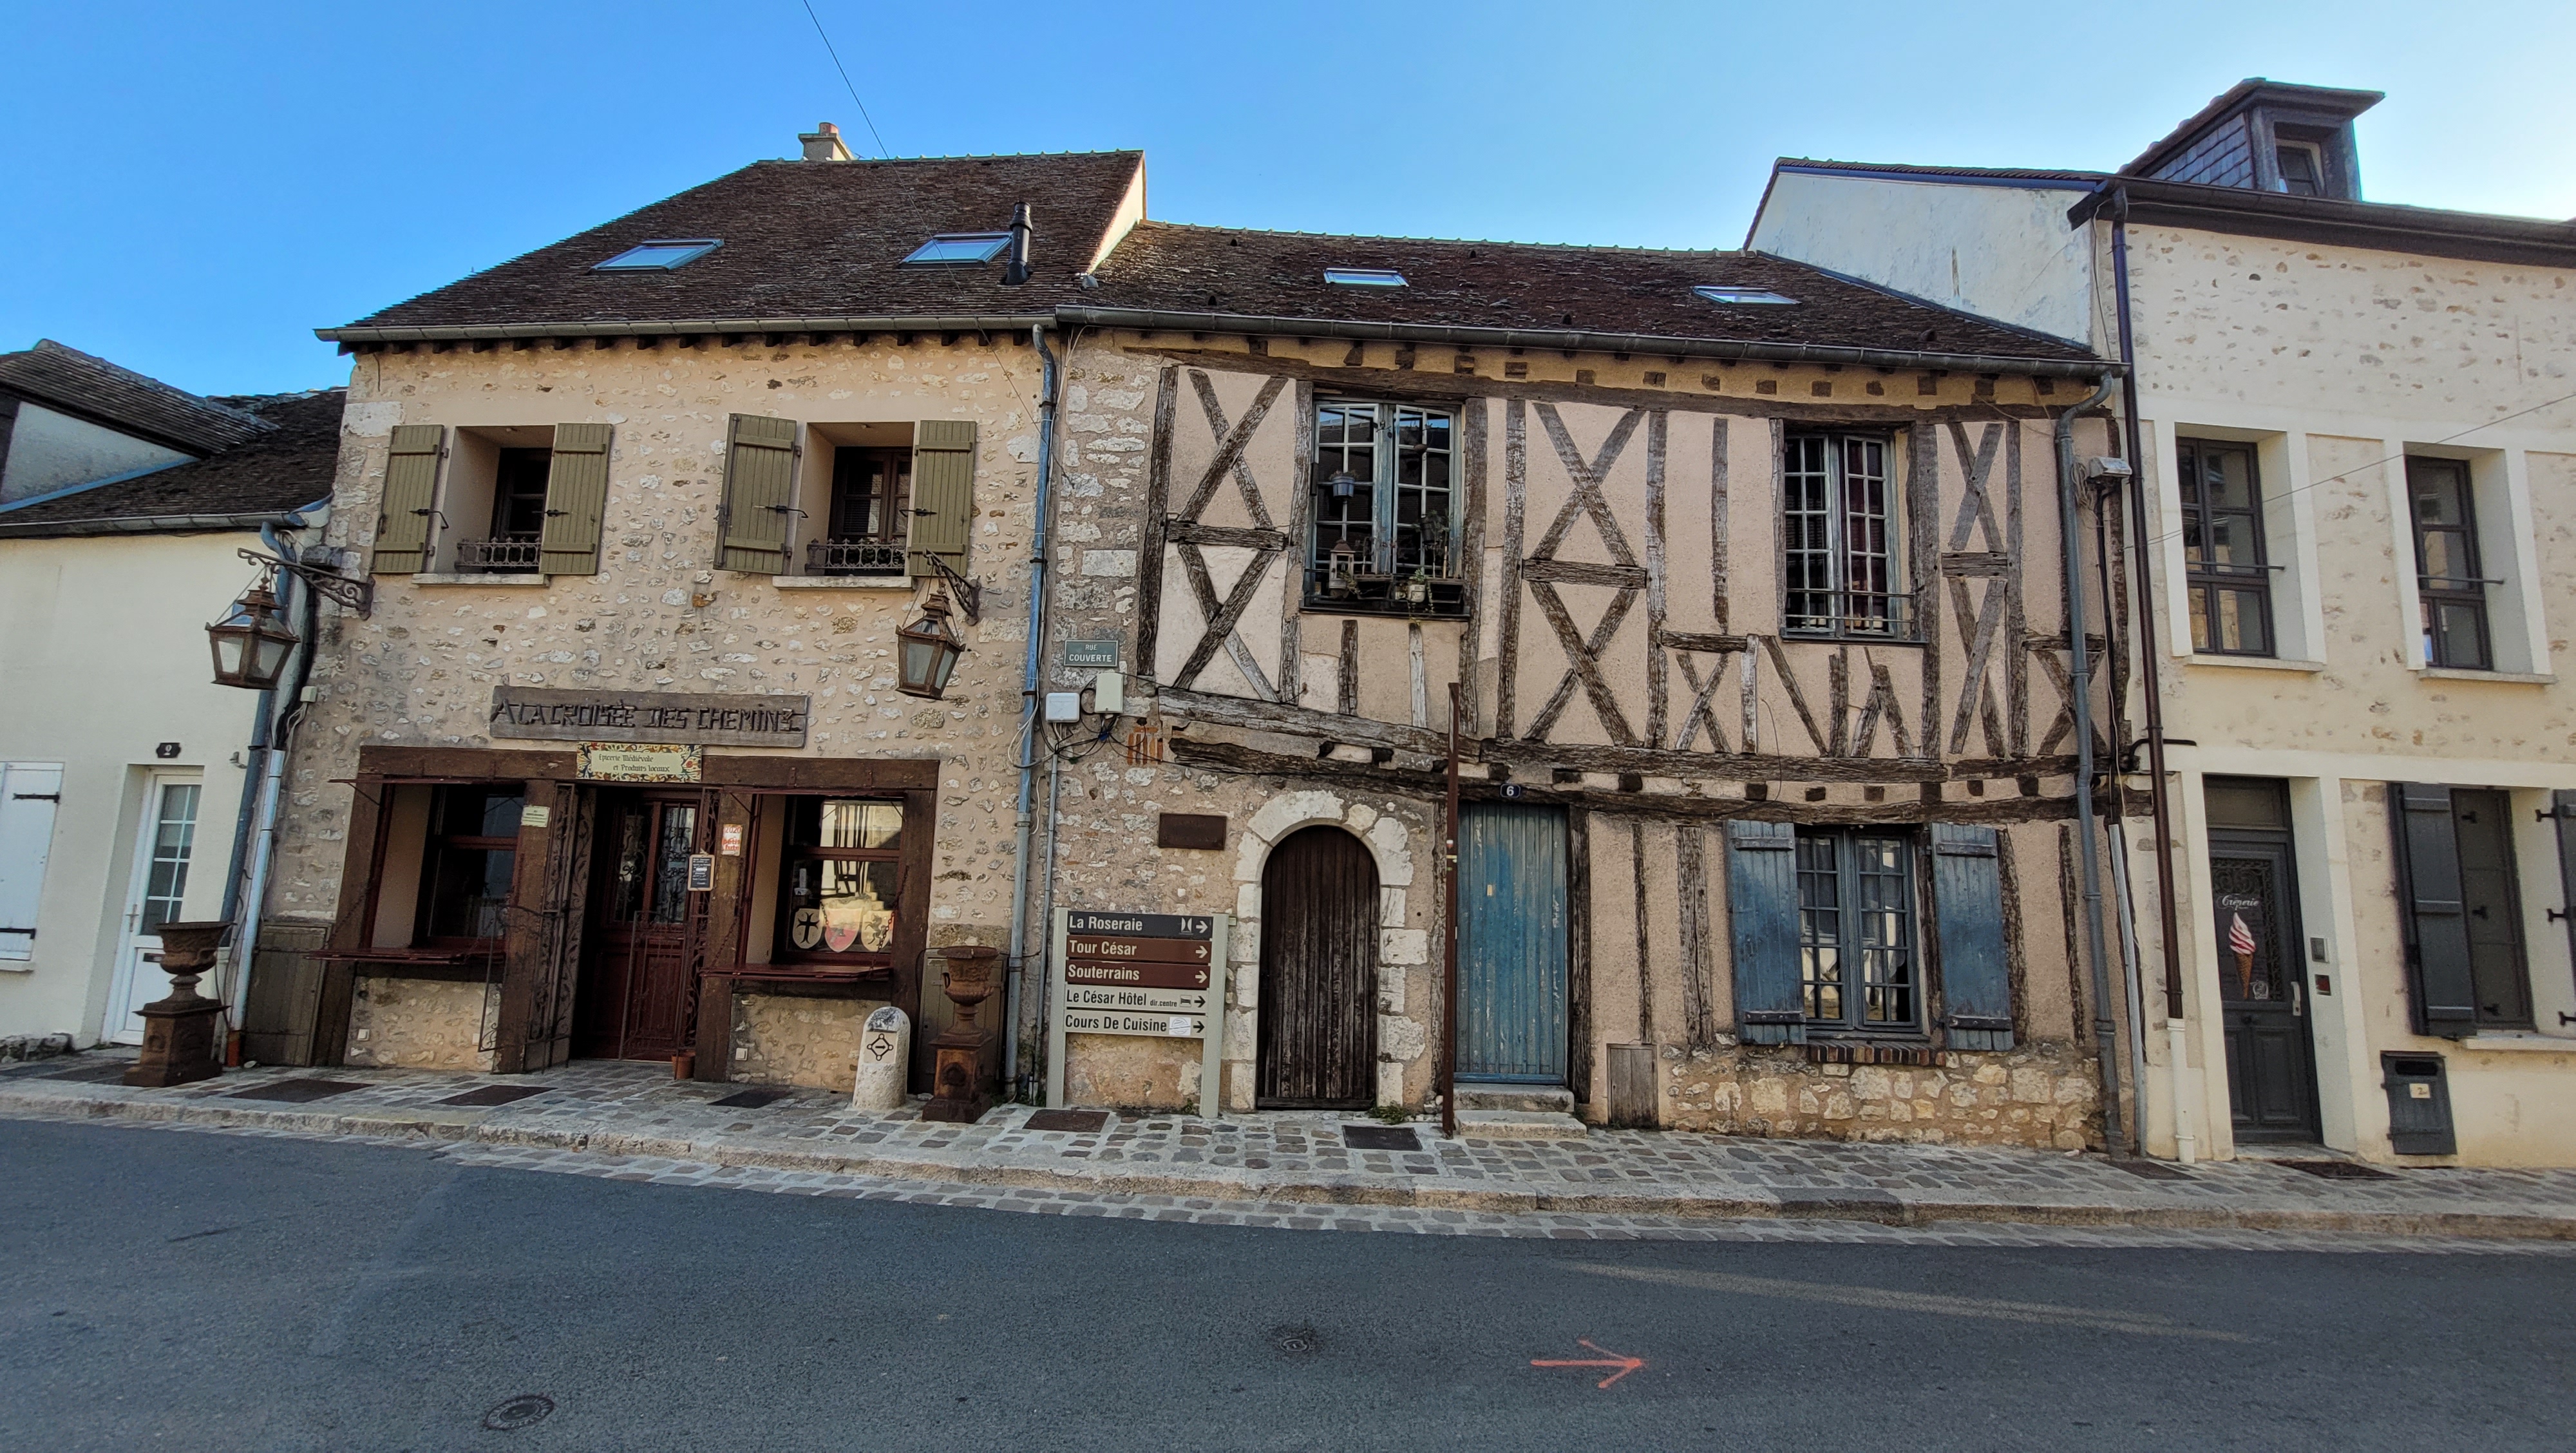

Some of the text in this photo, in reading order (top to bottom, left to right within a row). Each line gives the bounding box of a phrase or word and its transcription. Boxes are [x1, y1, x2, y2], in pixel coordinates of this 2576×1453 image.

[1069, 654, 1112, 663] COUVERTE
[643, 707, 687, 728] DES
[697, 707, 803, 732] CHEMINS
[1506, 786, 1514, 796] 6
[1069, 915, 1143, 931] La Roseraie
[1069, 940, 1137, 956] Tour César
[1068, 964, 1140, 980] Souterrains
[1066, 989, 1079, 1002] Le
[1083, 990, 1115, 1004] César
[1119, 991, 1147, 1005] Hôtel
[1065, 1014, 1167, 1032] Cours De Cuisine
